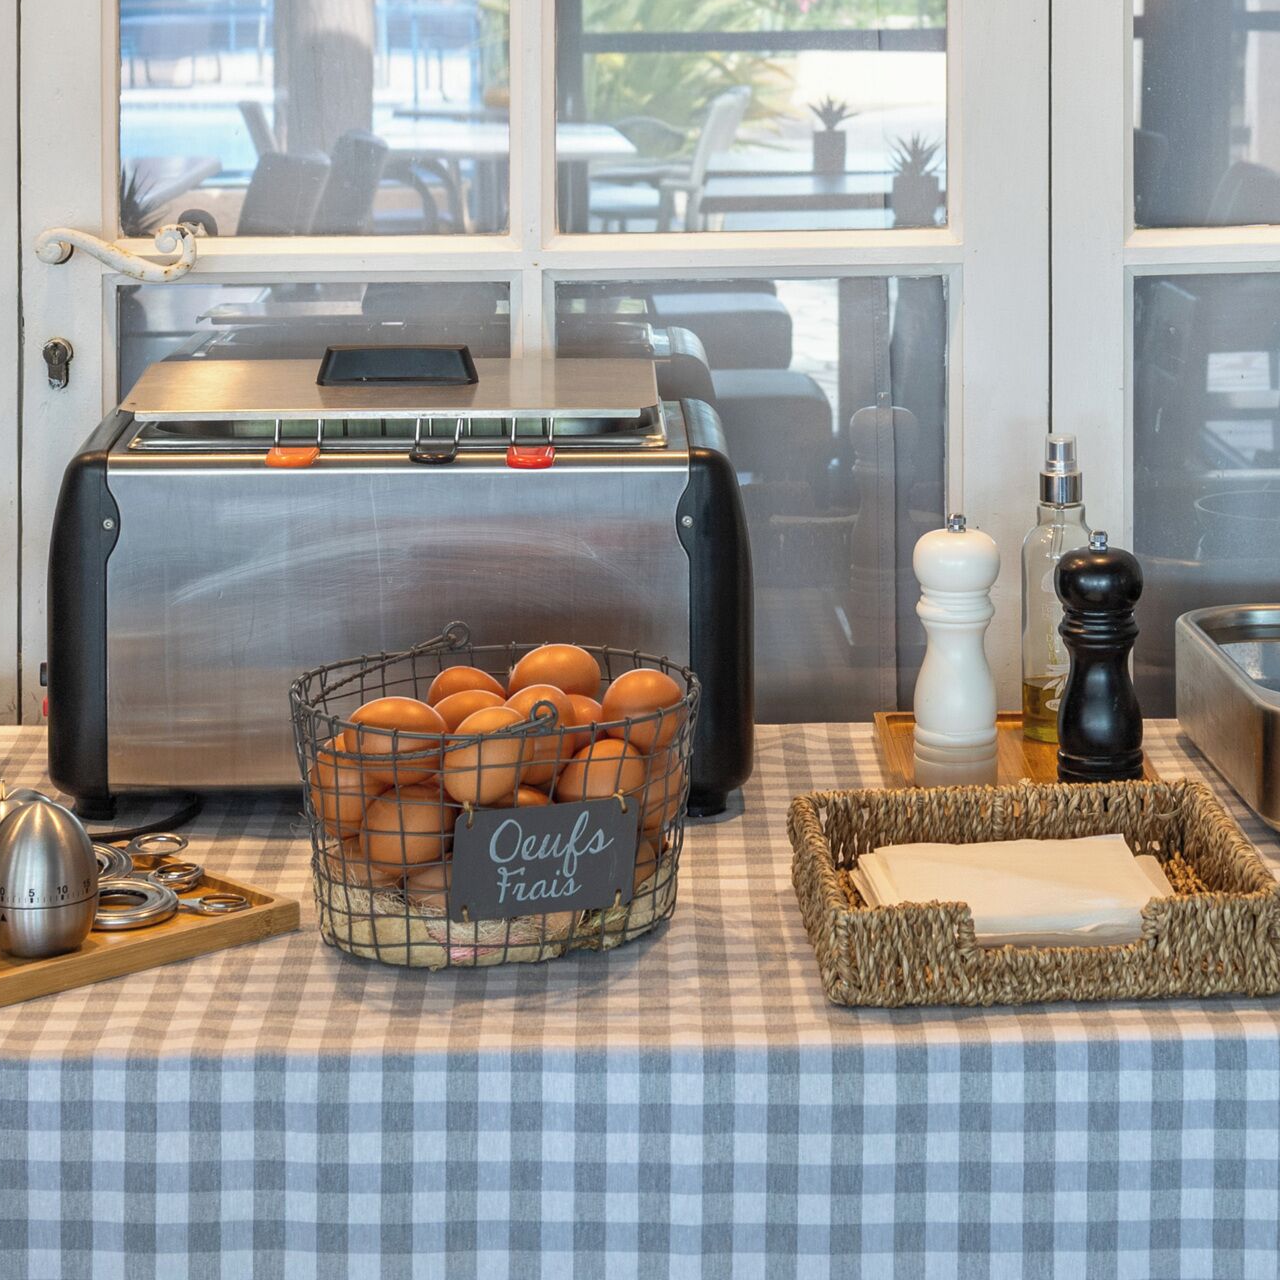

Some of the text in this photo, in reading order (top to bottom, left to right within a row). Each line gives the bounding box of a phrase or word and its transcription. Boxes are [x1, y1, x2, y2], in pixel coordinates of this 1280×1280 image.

[489, 810, 615, 878] Oeufs
[56, 885, 68, 894] 10
[497, 866, 582, 904] Frais
